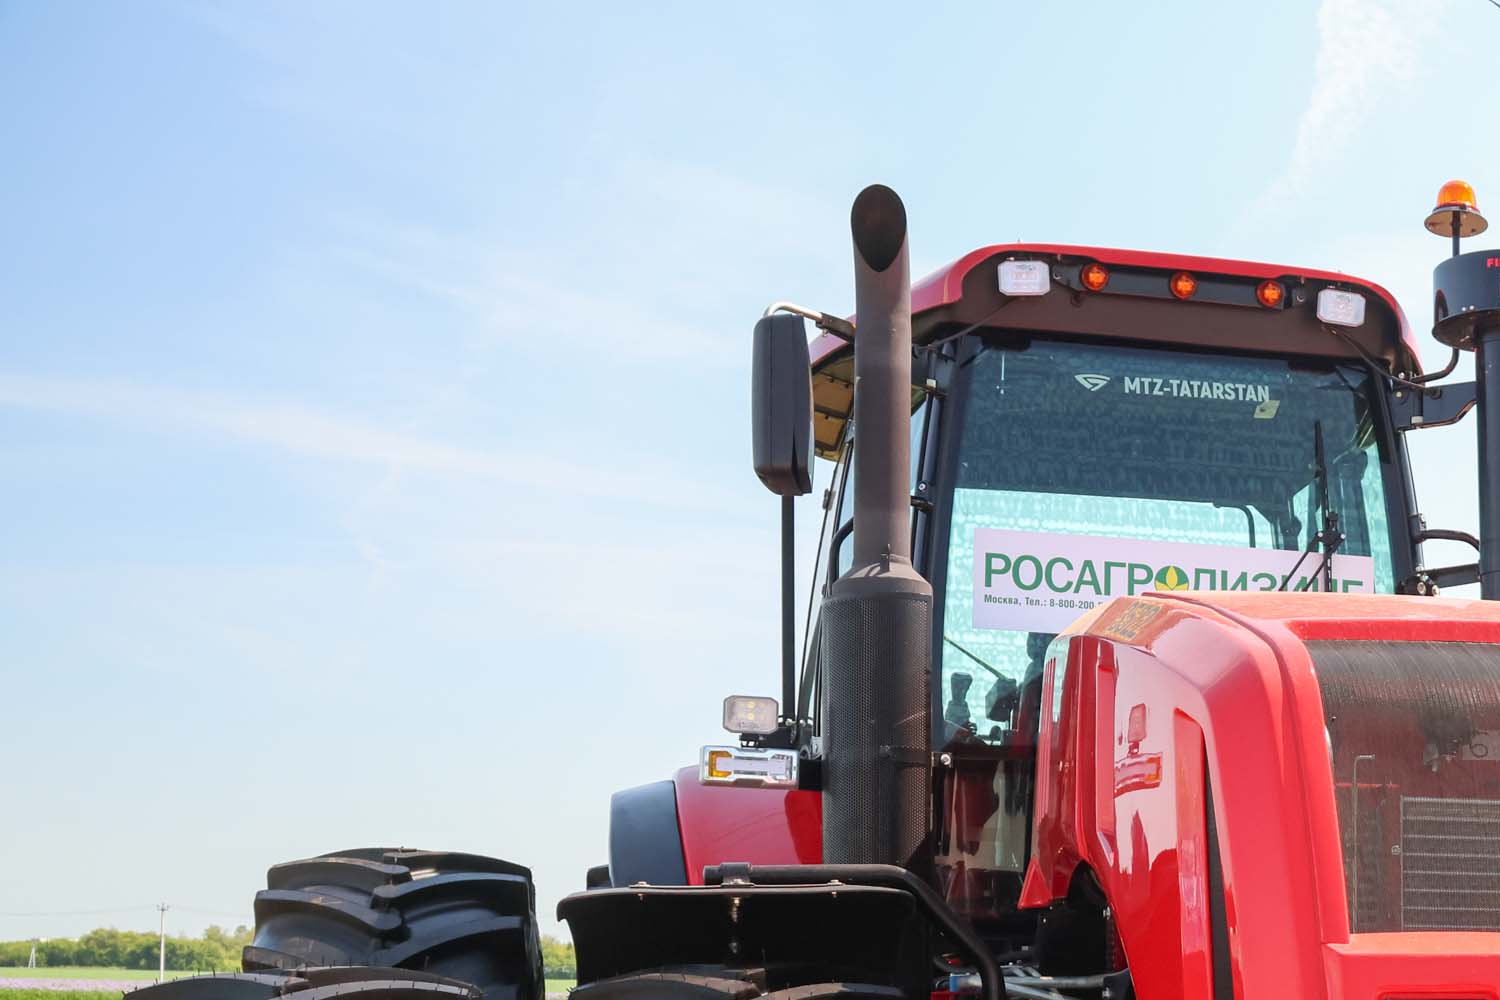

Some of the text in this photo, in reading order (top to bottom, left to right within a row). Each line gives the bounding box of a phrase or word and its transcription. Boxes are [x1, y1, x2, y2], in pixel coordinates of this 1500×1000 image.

[1124, 376, 1269, 402] MTZ-TATARSTAN
[984, 594, 1103, 609] Москва, Тел.: 8-800-200-
